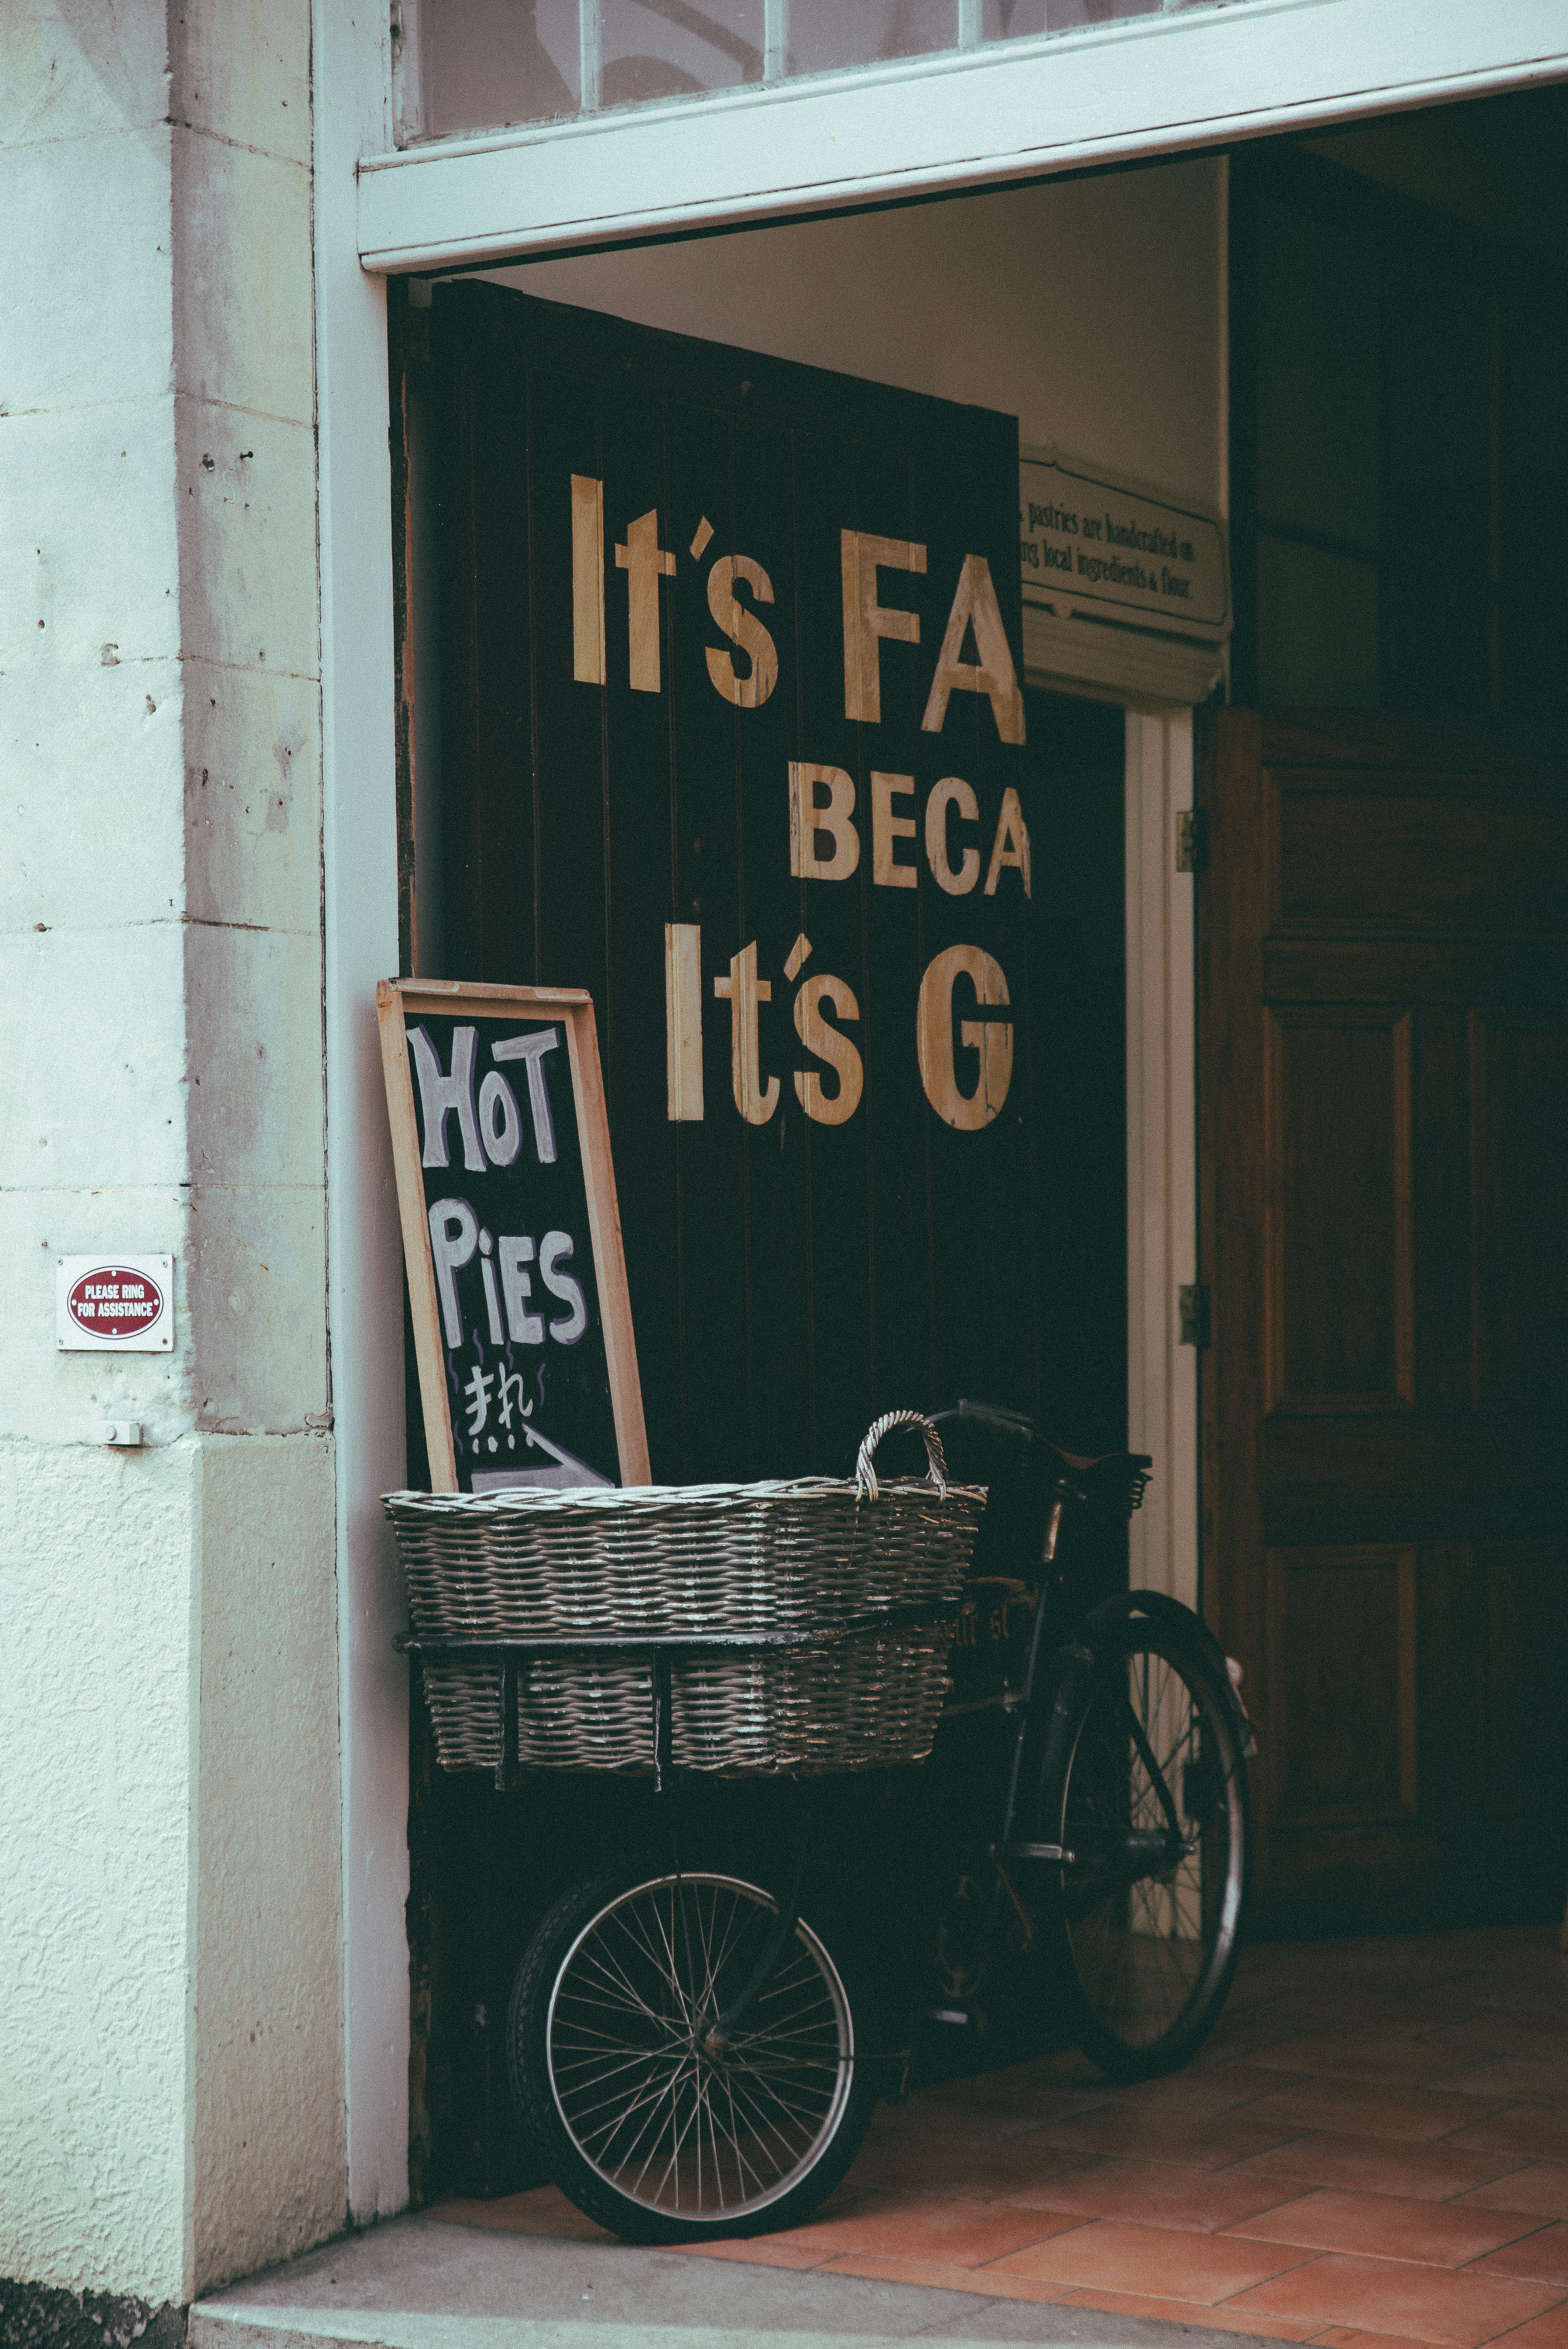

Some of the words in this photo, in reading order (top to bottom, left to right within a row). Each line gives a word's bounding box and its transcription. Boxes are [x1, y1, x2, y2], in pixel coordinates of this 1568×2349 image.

[1028, 501, 1079, 535] pastries
[1083, 518, 1102, 541] are
[1106, 513, 1178, 558] handcrafted
[1043, 539, 1072, 572] local
[1077, 547, 1146, 589] ingredients
[1148, 572, 1158, 592] &
[571, 473, 779, 708] It's
[841, 528, 1026, 746] FA
[788, 761, 1032, 899] BECA
[665, 922, 864, 1125] It's
[917, 944, 1014, 1130] G
[78, 1302, 95, 1317] FOR
[98, 1302, 153, 1317] ASSISTANCE
[85, 1285, 119, 1299] PLEASE
[121, 1284, 144, 1299] RING
